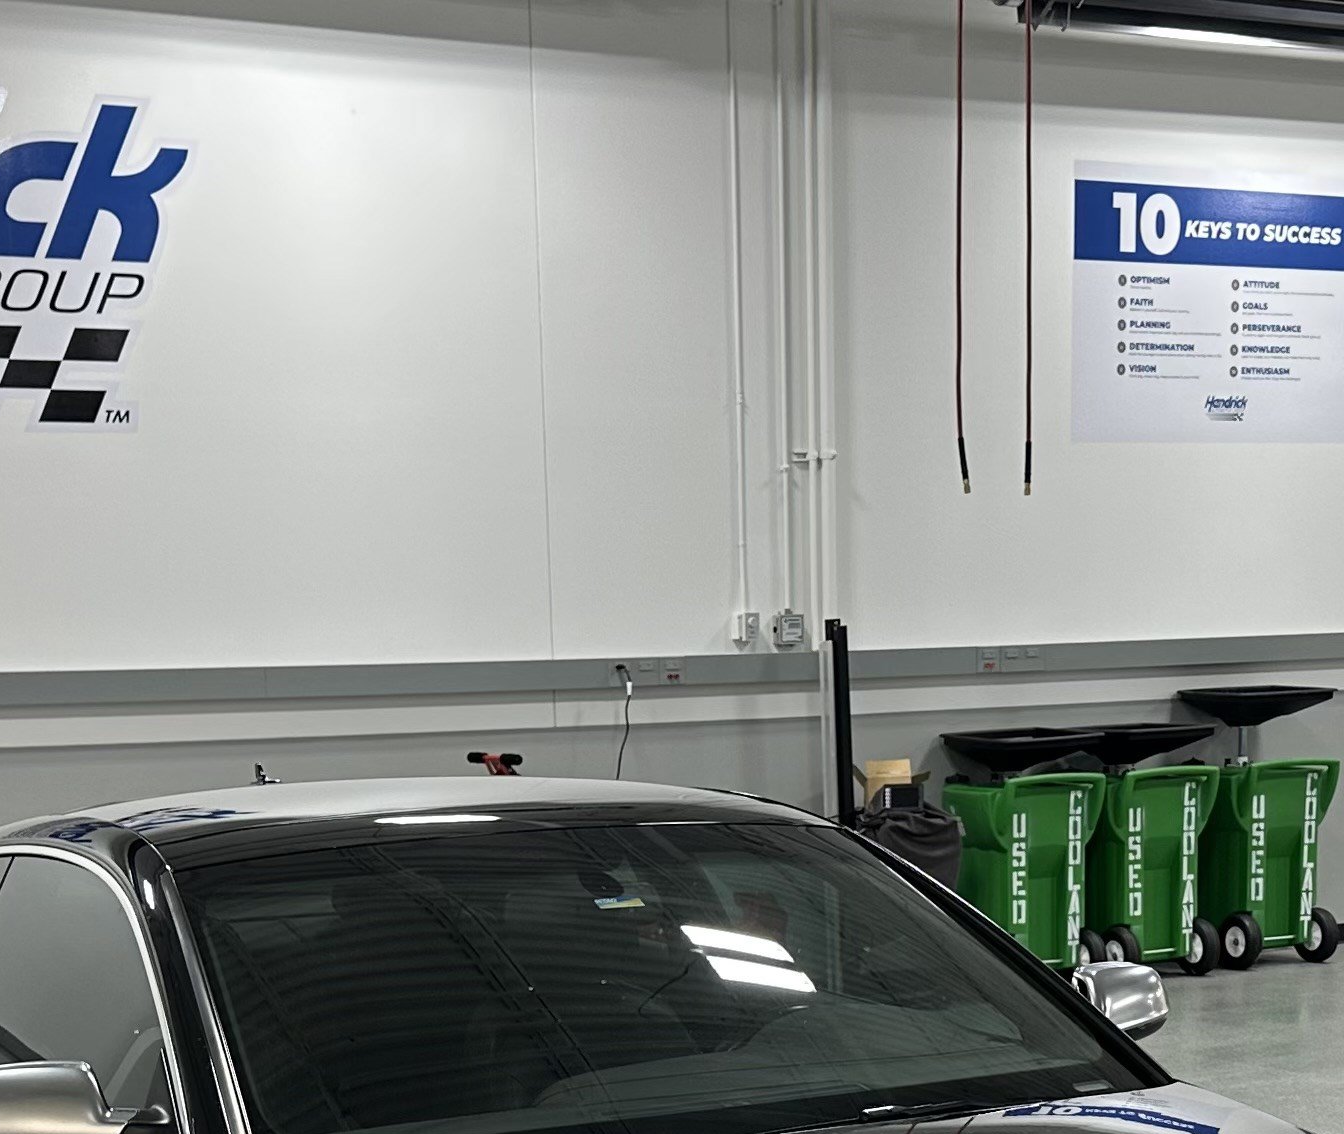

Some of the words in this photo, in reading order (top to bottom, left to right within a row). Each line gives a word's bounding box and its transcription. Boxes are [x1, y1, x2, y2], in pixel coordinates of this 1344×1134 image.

[1112, 191, 1181, 256] 10
[1185, 220, 1232, 241] KEYS
[1236, 222, 1260, 243] TO
[1264, 224, 1343, 246] SUCCESS
[1130, 275, 1170, 285] OPTIMISM
[1243, 280, 1280, 289] ATTITUDE
[1129, 298, 1154, 307] FAITH
[1242, 302, 1268, 310] GOALS
[1129, 320, 1171, 329] PLANNING
[1242, 324, 1301, 333] PERSEVERANCE
[1129, 342, 1194, 351] DETERMINATION
[1241, 345, 1290, 354] KNOWLEDGE
[1129, 365, 1157, 373] VISION
[1241, 366, 1290, 375] ENTHUSIASM
[1204, 395, 1248, 413] Hendrick
[1250, 794, 1266, 903] USED
[1128, 806, 1143, 917] USED
[1300, 772, 1319, 947] COOLANT
[1012, 812, 1027, 925] USED
[1182, 781, 1197, 954] COOLANT
[1067, 790, 1084, 966] COOLANT
